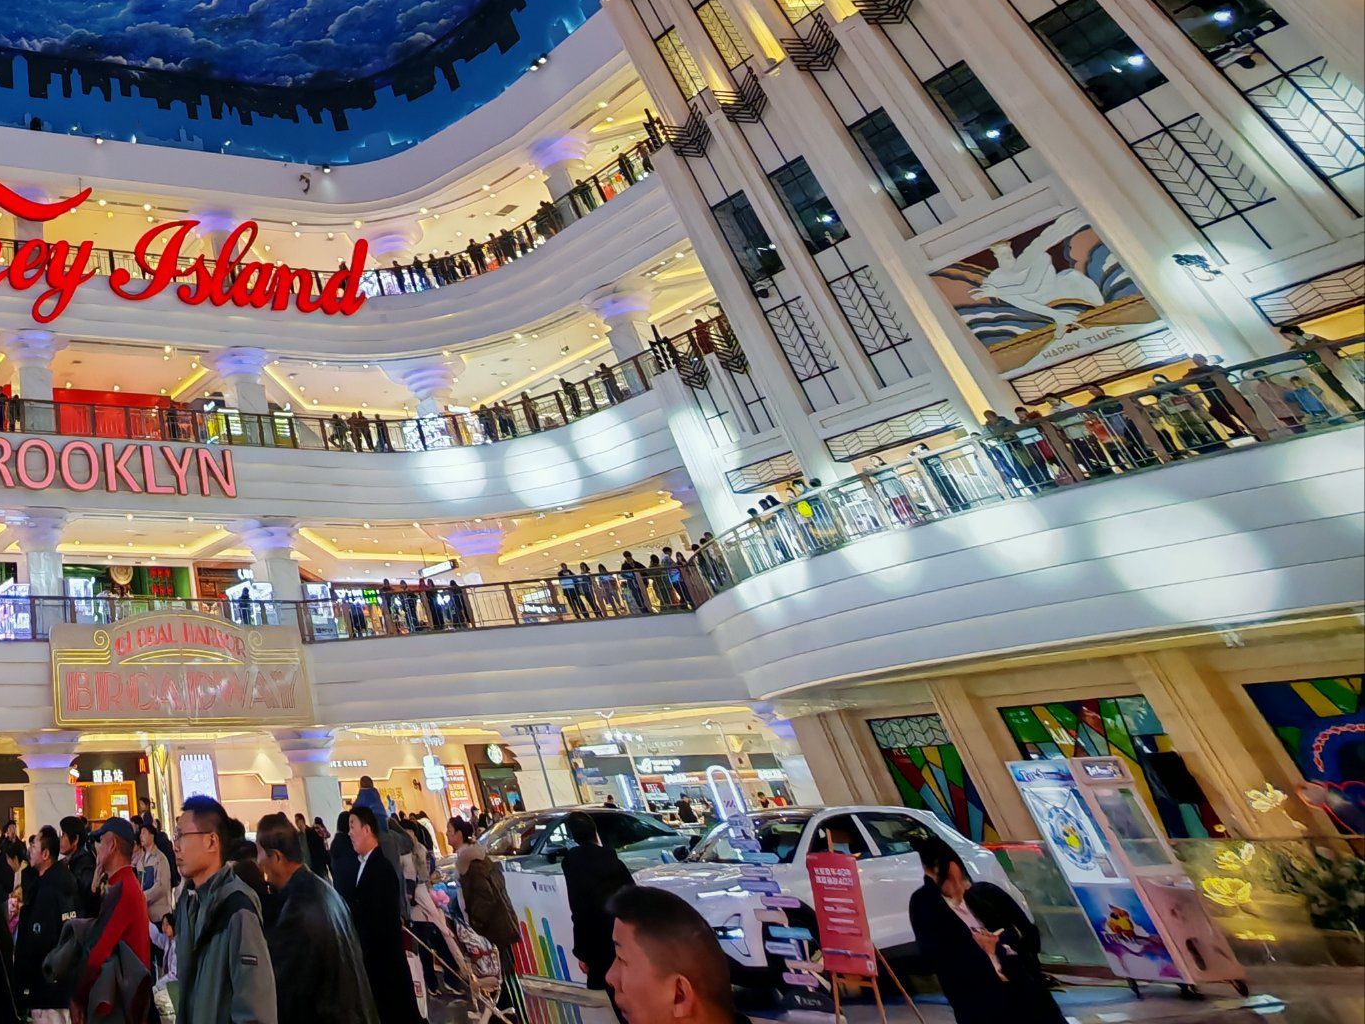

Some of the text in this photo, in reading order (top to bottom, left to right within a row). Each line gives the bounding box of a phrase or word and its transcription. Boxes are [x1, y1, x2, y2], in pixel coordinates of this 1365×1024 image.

[110, 220, 370, 316] Island
[1042, 326, 1125, 360] HAPPY TIMES
[114, 622, 247, 658] GLOBAL HARBOR
[66, 671, 297, 711] BROADWAY
[92, 769, 124, 783] 甜品站
